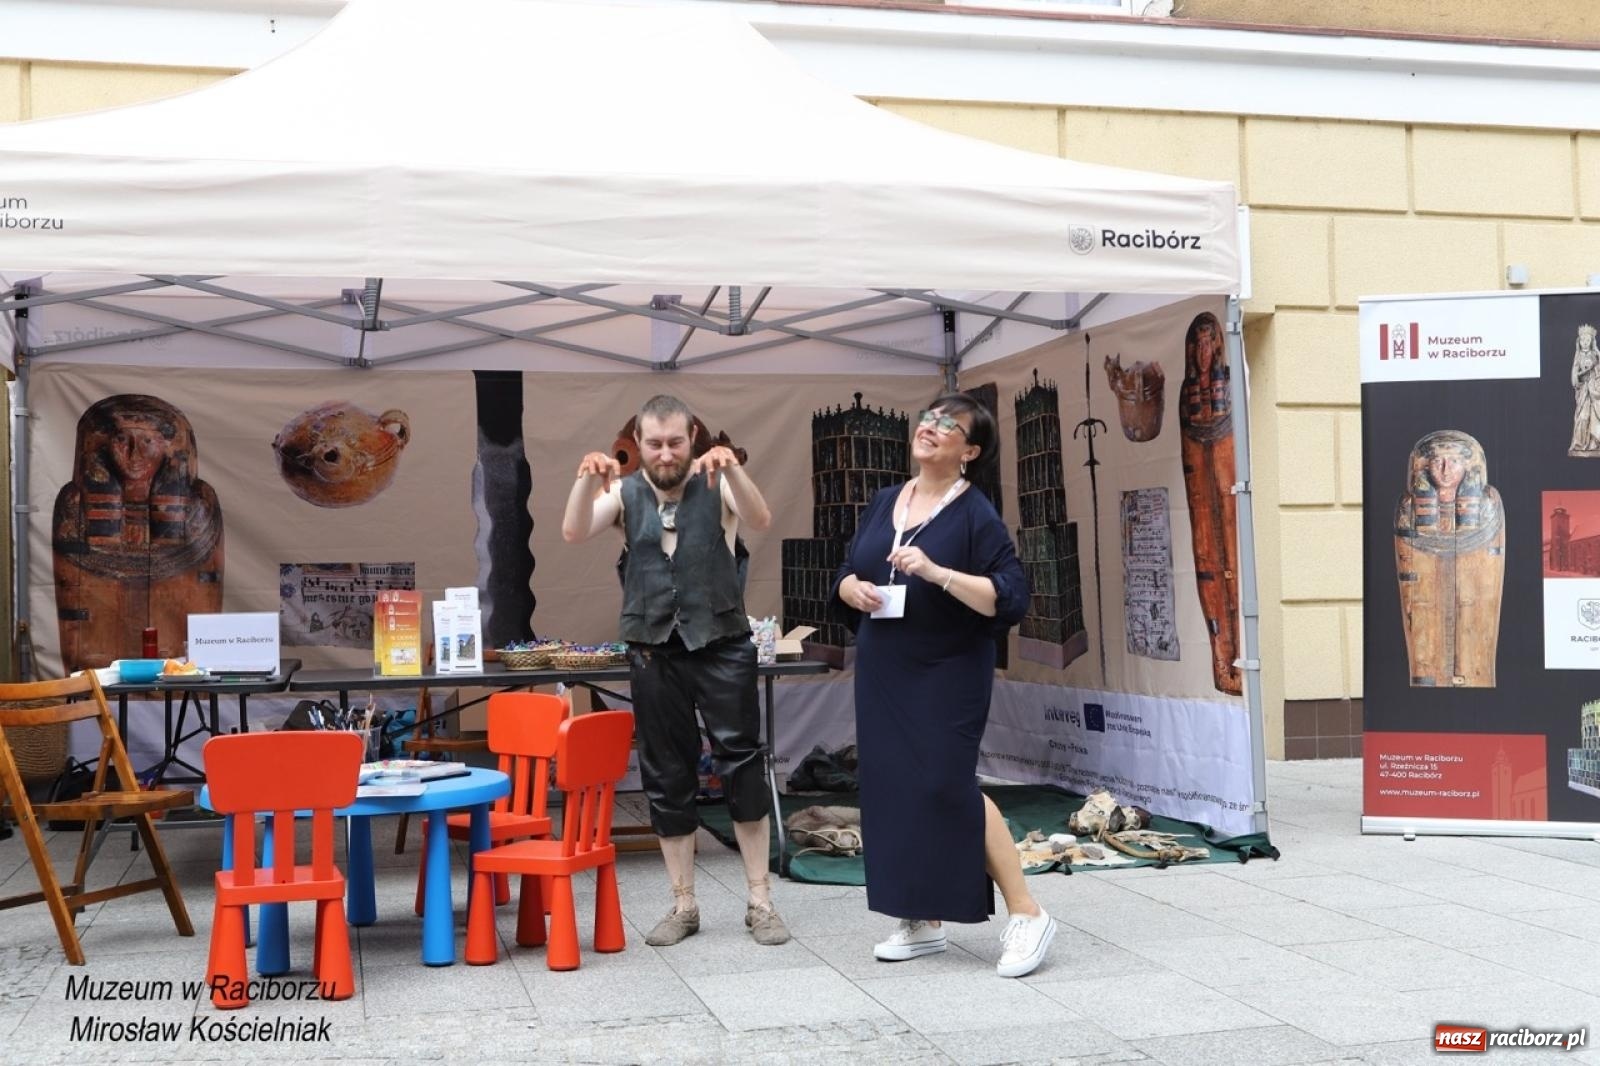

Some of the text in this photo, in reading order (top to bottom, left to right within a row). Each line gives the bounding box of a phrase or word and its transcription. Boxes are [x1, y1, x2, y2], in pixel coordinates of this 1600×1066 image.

[1101, 229, 1202, 250] Racibórz
[1428, 335, 1483, 346] Muzeum
[1428, 347, 1507, 359] w Raciborzu
[195, 637, 227, 645] Muzeum
[236, 635, 274, 644] Raciborzu
[1379, 754, 1414, 762] Muzeum
[1424, 754, 1464, 762] Raciborzu
[1408, 771, 1443, 779] Racibórz
[1379, 789, 1480, 798] www.muzeum-raciborz.pl
